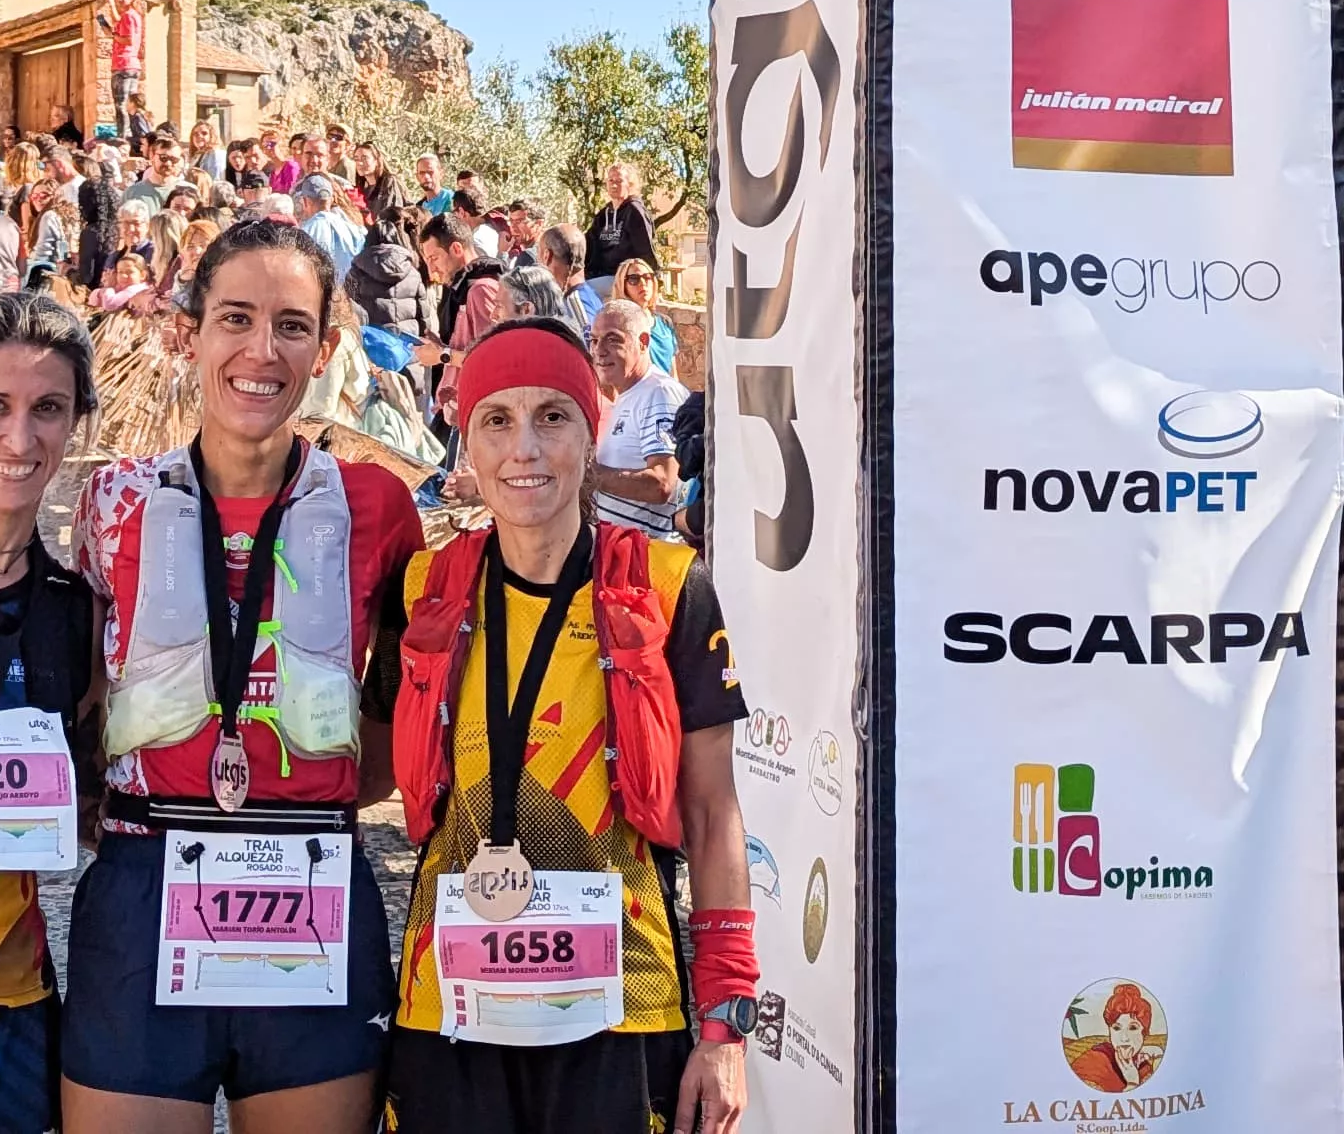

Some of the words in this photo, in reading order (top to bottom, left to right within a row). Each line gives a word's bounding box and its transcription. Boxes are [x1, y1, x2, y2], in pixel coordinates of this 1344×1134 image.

[1020, 88, 1112, 112] julián
[1114, 95, 1223, 116] mairal
[982, 467, 1258, 514] novaPET
[942, 612, 1311, 666] SCARPA
[214, 758, 247, 792] utgs
[244, 839, 284, 852] TRAIL
[246, 864, 283, 872] ROSADO
[211, 890, 304, 924] 1777
[480, 930, 575, 964] 1658
[541, 965, 574, 974] CASTILLO
[1003, 1101, 1044, 1124] LA
[1048, 1088, 1206, 1122] CALANDINA
